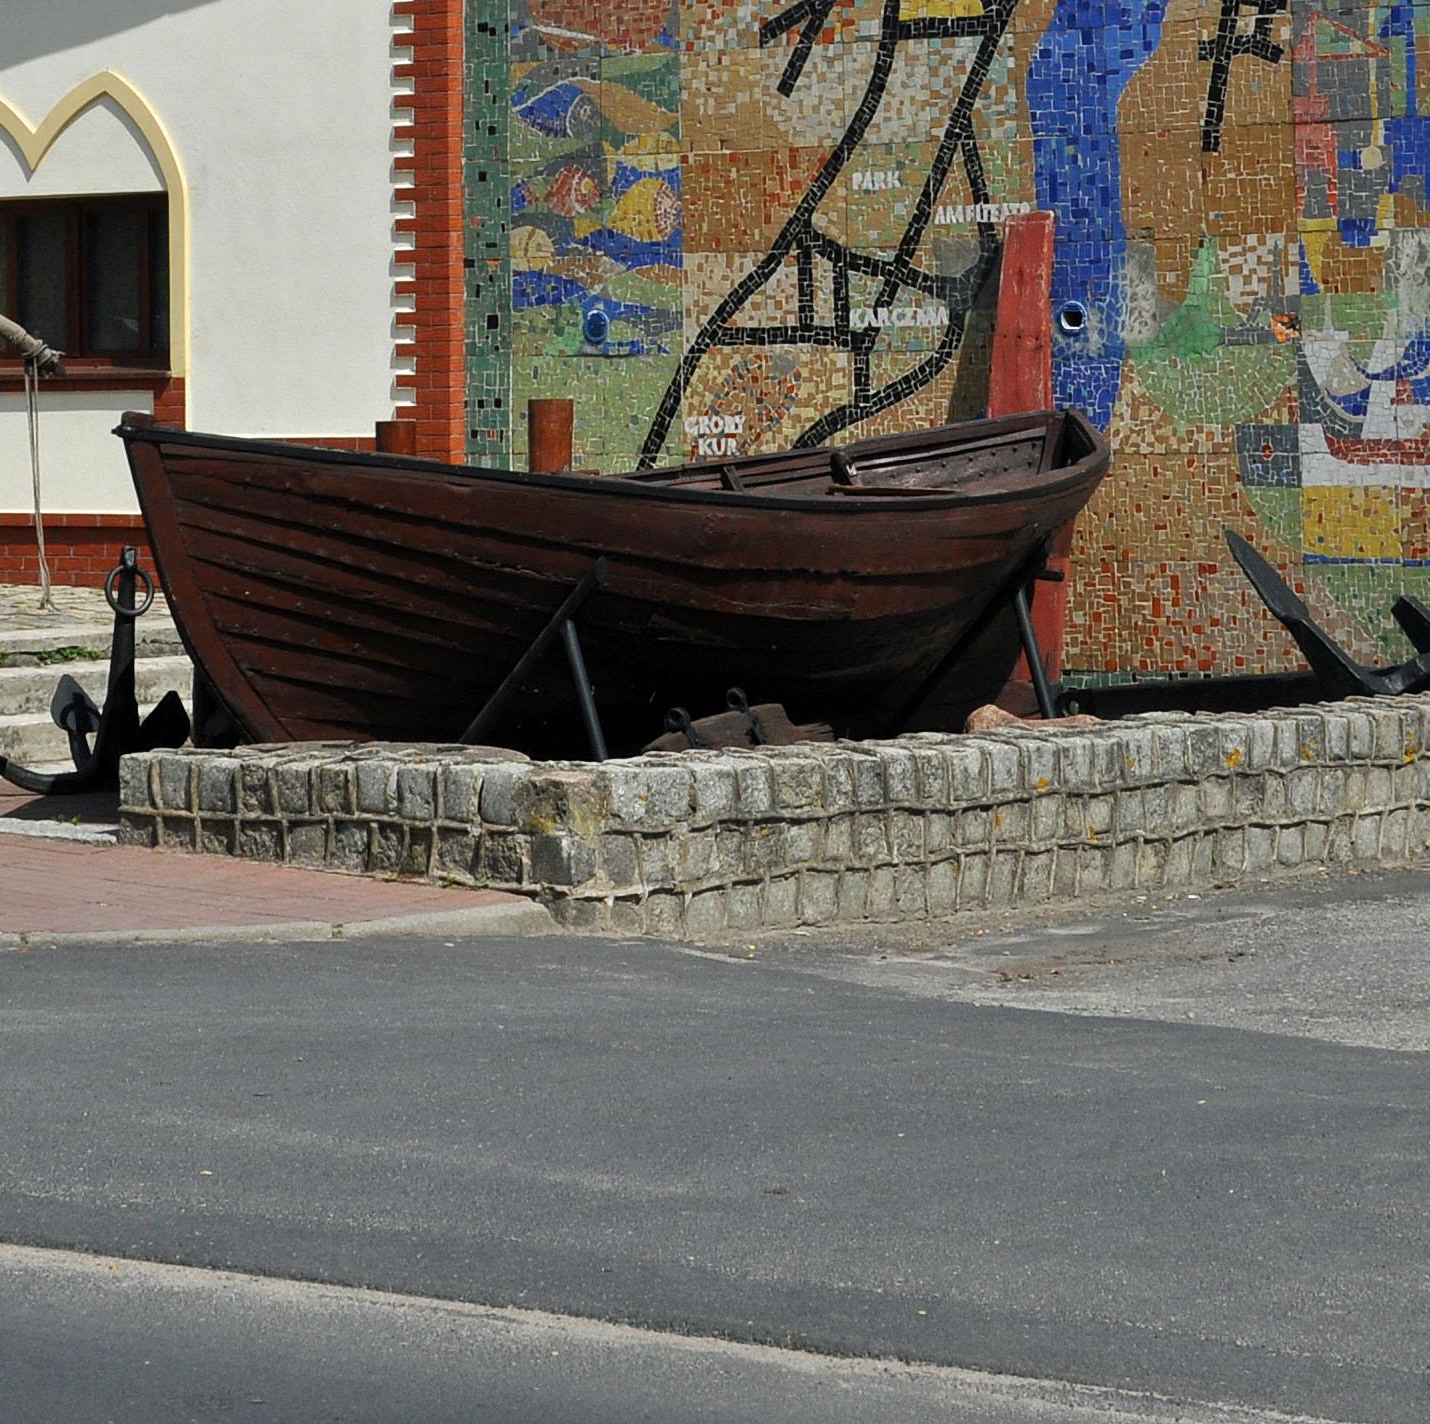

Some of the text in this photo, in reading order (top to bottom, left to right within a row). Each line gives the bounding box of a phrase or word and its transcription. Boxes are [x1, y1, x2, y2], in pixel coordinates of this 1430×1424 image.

[851, 171, 902, 190] PARK
[849, 306, 950, 328] KARCZMA
[684, 414, 746, 436] GROBY
